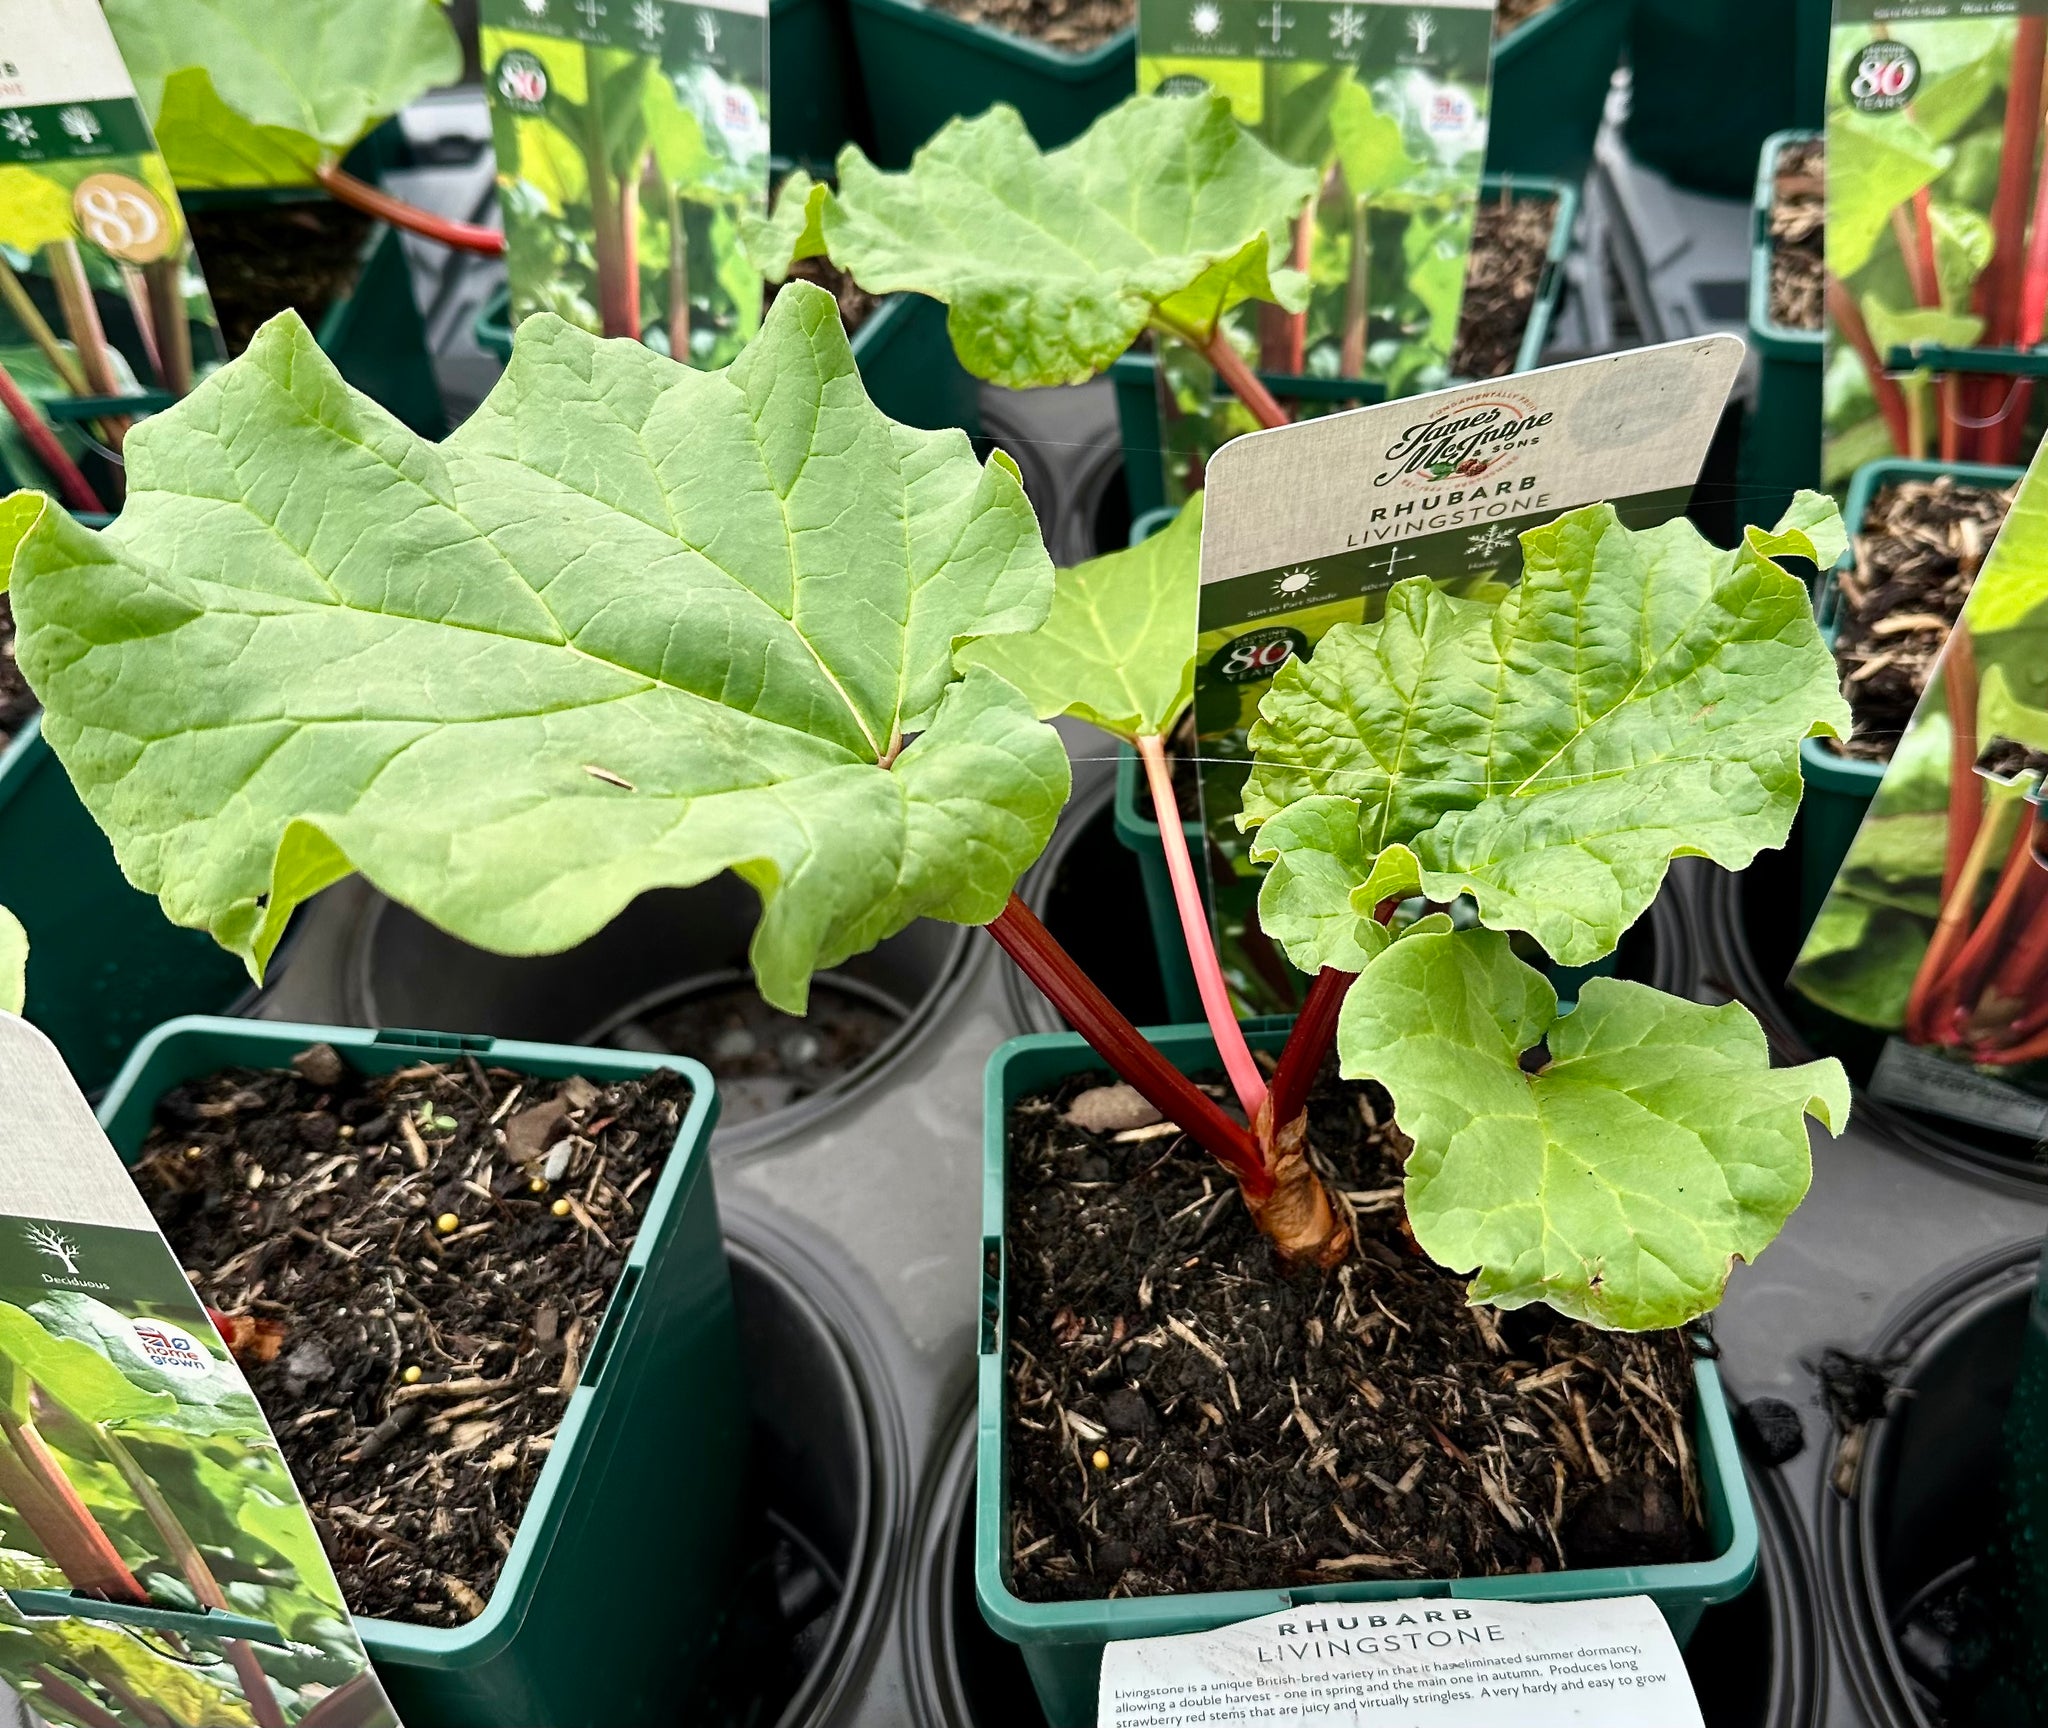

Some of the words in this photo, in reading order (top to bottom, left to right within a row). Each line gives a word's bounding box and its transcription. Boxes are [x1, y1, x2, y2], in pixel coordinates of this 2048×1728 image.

[1850, 55, 1917, 98] 80
[81, 185, 158, 250] 80
[1373, 411, 1554, 487] McIntyre
[1385, 407, 1502, 461] James
[1492, 436, 1540, 453] SONS
[1370, 476, 1537, 522] RHUBARB
[1346, 493, 1552, 548] LIVINGSTONE
[1467, 560, 1499, 571] Hardy
[1247, 608, 1267, 618] Sun
[1269, 604, 1280, 612] to
[1282, 599, 1303, 609] Part
[1306, 592, 1338, 605] Shade
[1222, 638, 1294, 674] 80
[1225, 664, 1279, 683] YEAR
[41, 1273, 110, 1290] Deciduous
[142, 1343, 199, 1361] home
[150, 1354, 206, 1371] grown
[1277, 1608, 1473, 1636] RHUBARB
[1257, 1624, 1505, 1663] LIVINGSTONE
[1115, 1685, 1185, 1700] Livingstone
[1188, 1684, 1197, 1692] is
[1211, 1680, 1253, 1694] unique
[1256, 1669, 1329, 1687] British-bred
[1332, 1668, 1374, 1683] variety
[1377, 1667, 1389, 1677] in
[1392, 1664, 1419, 1675] that
[1421, 1662, 1431, 1673] it
[1433, 1660, 1454, 1671] has
[1458, 1653, 1522, 1669] eliminated
[1525, 1650, 1573, 1663] summer
[1577, 1643, 1642, 1659] dormancy,
[1116, 1700, 1166, 1713] allowing
[1169, 1701, 1176, 1709] a
[1179, 1694, 1222, 1708] double
[1225, 1692, 1271, 1705] harvest
[1284, 1689, 1308, 1699] one
[1311, 1686, 1322, 1697] in
[1325, 1683, 1364, 1698] spring
[1366, 1680, 1389, 1692] and
[1393, 1678, 1414, 1690] the
[1417, 1675, 1447, 1687] main
[1450, 1674, 1474, 1684] one
[1477, 1670, 1489, 1682] in
[1492, 1669, 1543, 1681] autumn.
[1549, 1660, 1607, 1676] Produces
[1609, 1658, 1639, 1672] long
[1116, 1711, 1183, 1728] strawberry
[1185, 1711, 1206, 1723] red
[1209, 1710, 1246, 1721] stems
[1250, 1706, 1275, 1718] that
[1279, 1704, 1298, 1715] are
[1302, 1702, 1330, 1717] juicy
[1333, 1698, 1356, 1711] and
[1359, 1694, 1409, 1709] virtually
[1413, 1690, 1475, 1705] stringless.
[1480, 1686, 1491, 1698] A
[1492, 1686, 1519, 1698] very
[1522, 1681, 1557, 1695] hardy
[1561, 1678, 1584, 1691] and
[1587, 1677, 1615, 1690] easy
[1618, 1676, 1632, 1686] to
[1635, 1673, 1667, 1687] grow
